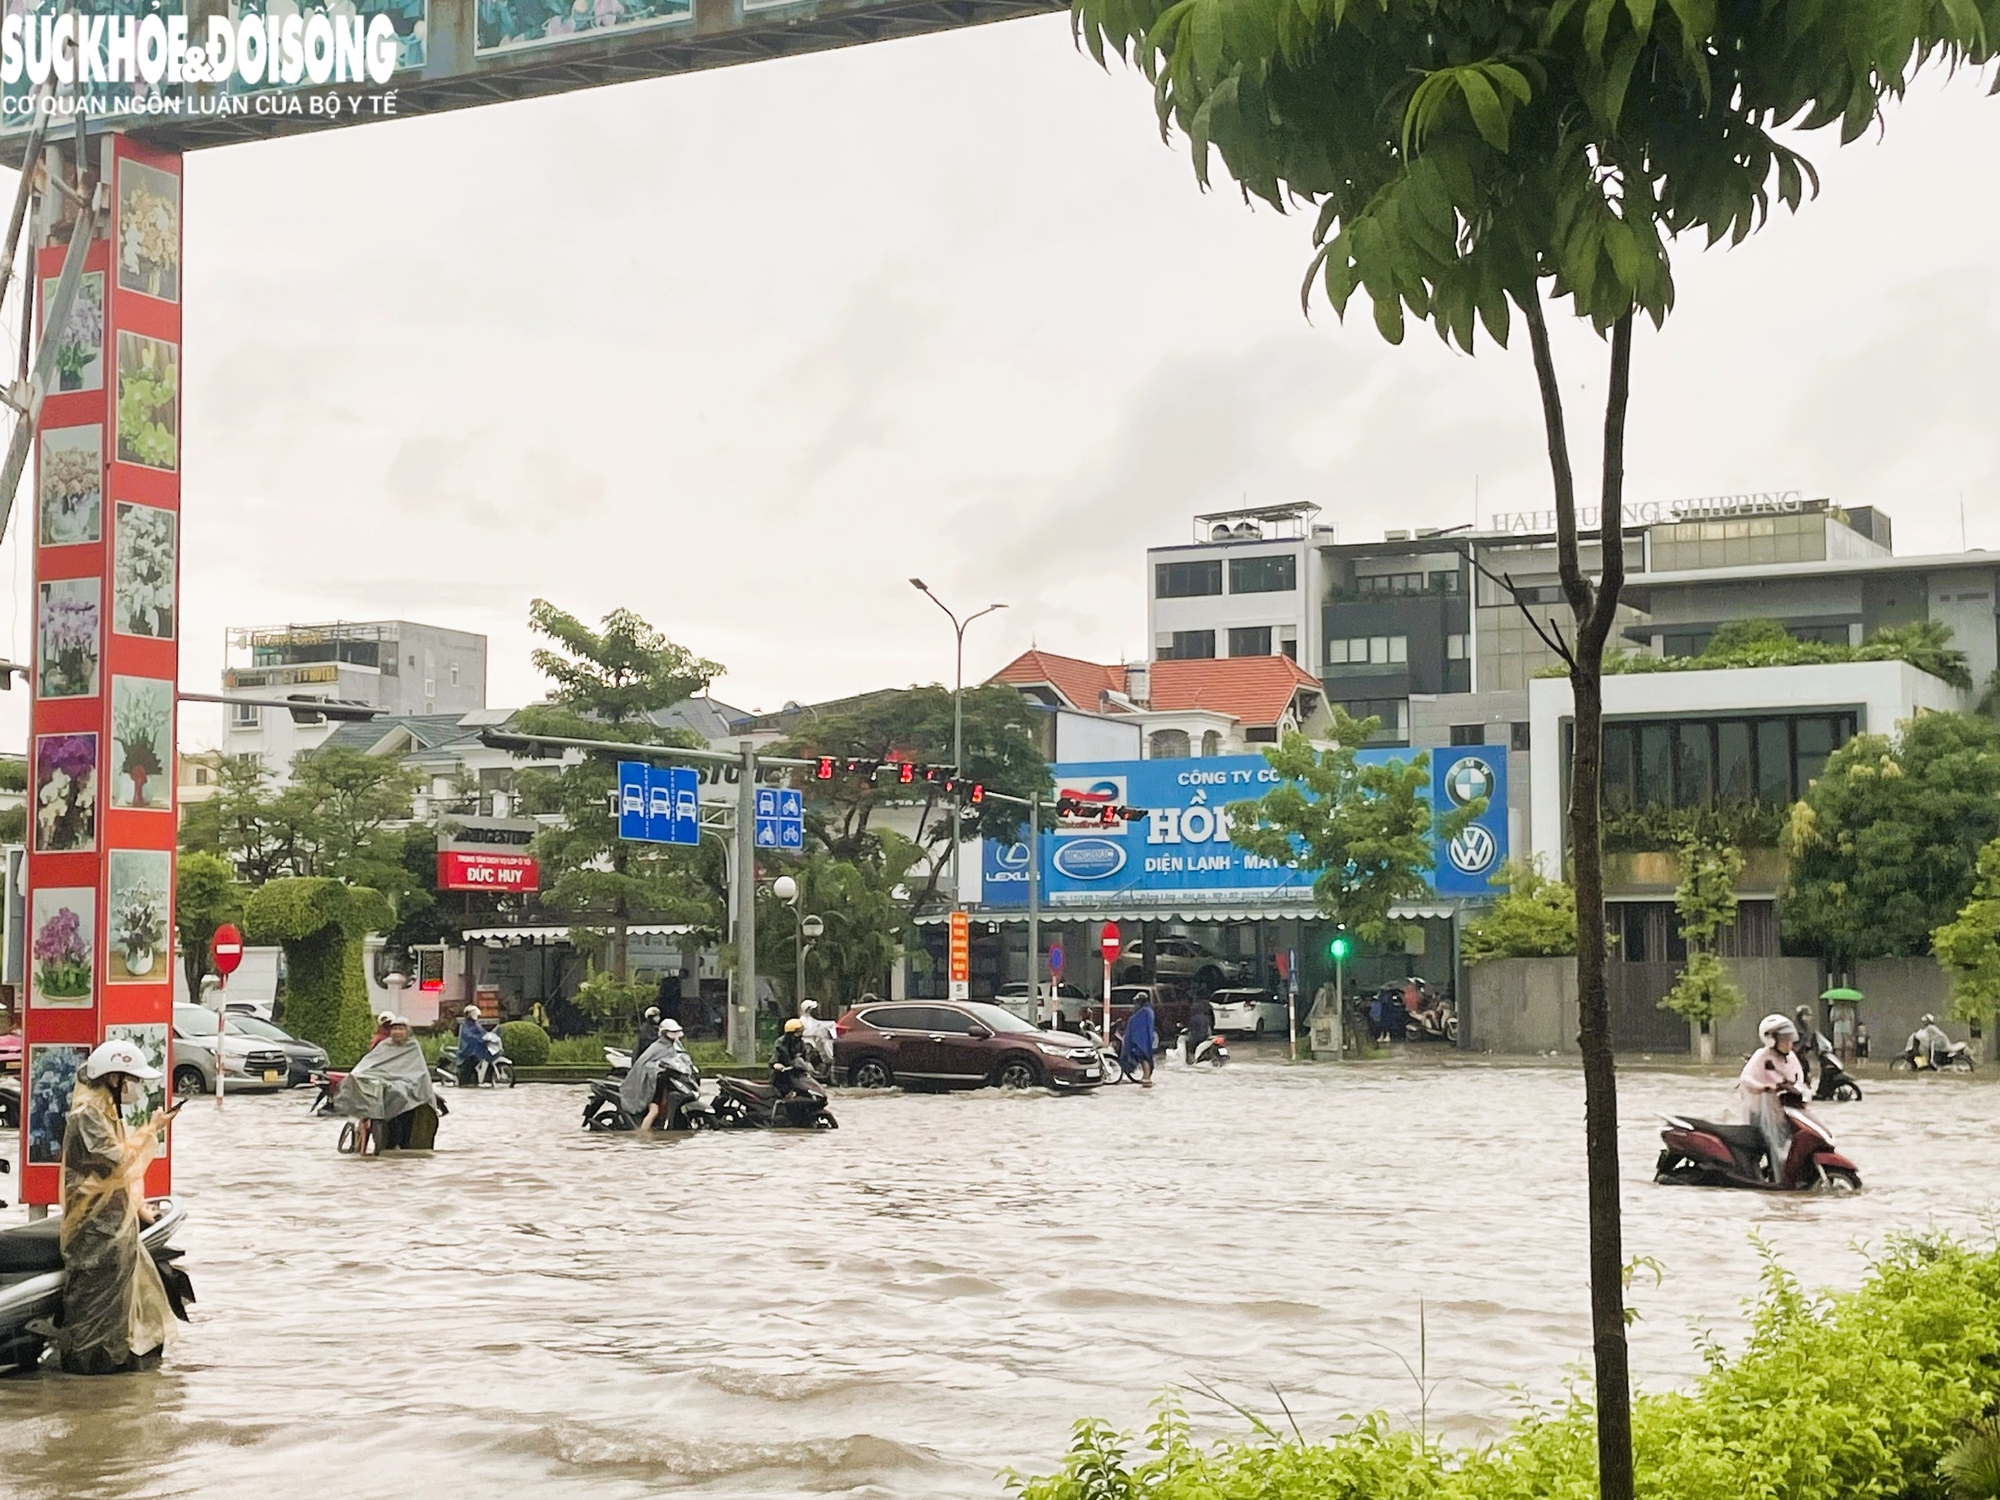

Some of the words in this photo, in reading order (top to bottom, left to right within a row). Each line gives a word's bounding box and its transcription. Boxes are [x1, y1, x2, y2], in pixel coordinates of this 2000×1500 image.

[1671, 490, 1802, 520] SHIPPING
[1177, 768, 1227, 786] CÔNG
[1230, 769, 1253, 784] TY
[1147, 788, 1258, 845] HỒN
[467, 864, 494, 883] ĐỨC
[498, 868, 523, 884] HUY
[1187, 855, 1231, 875] LẠNH
